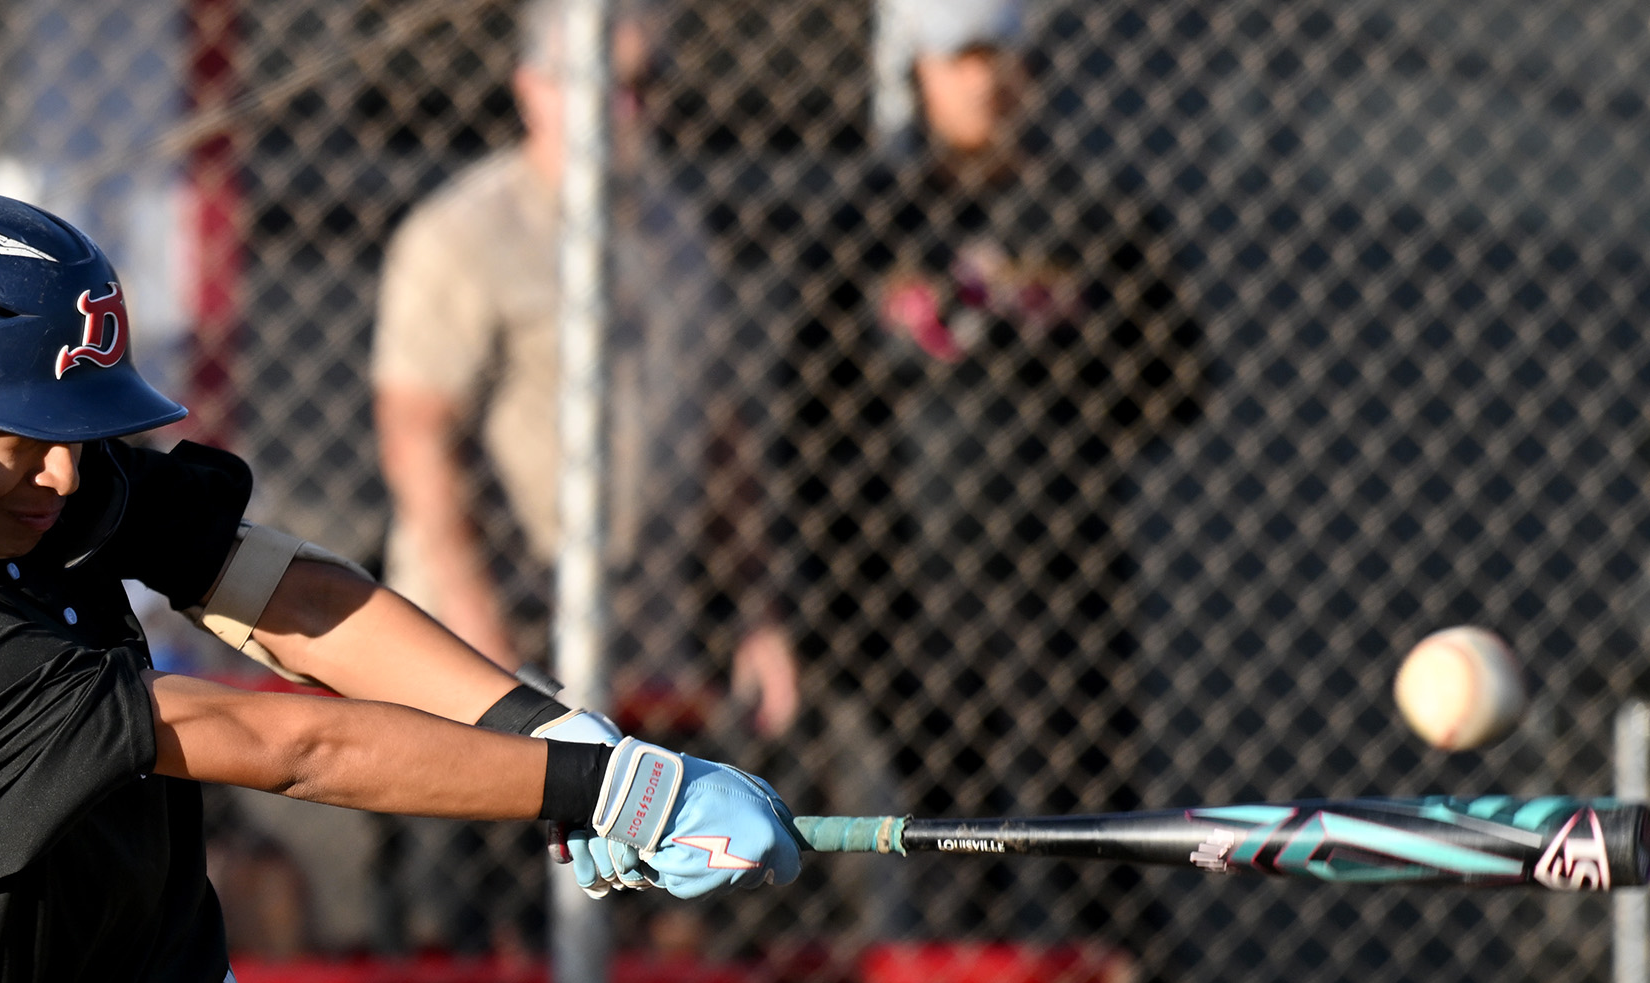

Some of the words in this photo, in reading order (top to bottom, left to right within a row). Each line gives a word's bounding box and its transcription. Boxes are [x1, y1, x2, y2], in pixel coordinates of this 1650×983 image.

[55, 281, 129, 380] D
[642, 760, 664, 804] BRUCE
[626, 809, 647, 839] BOLT
